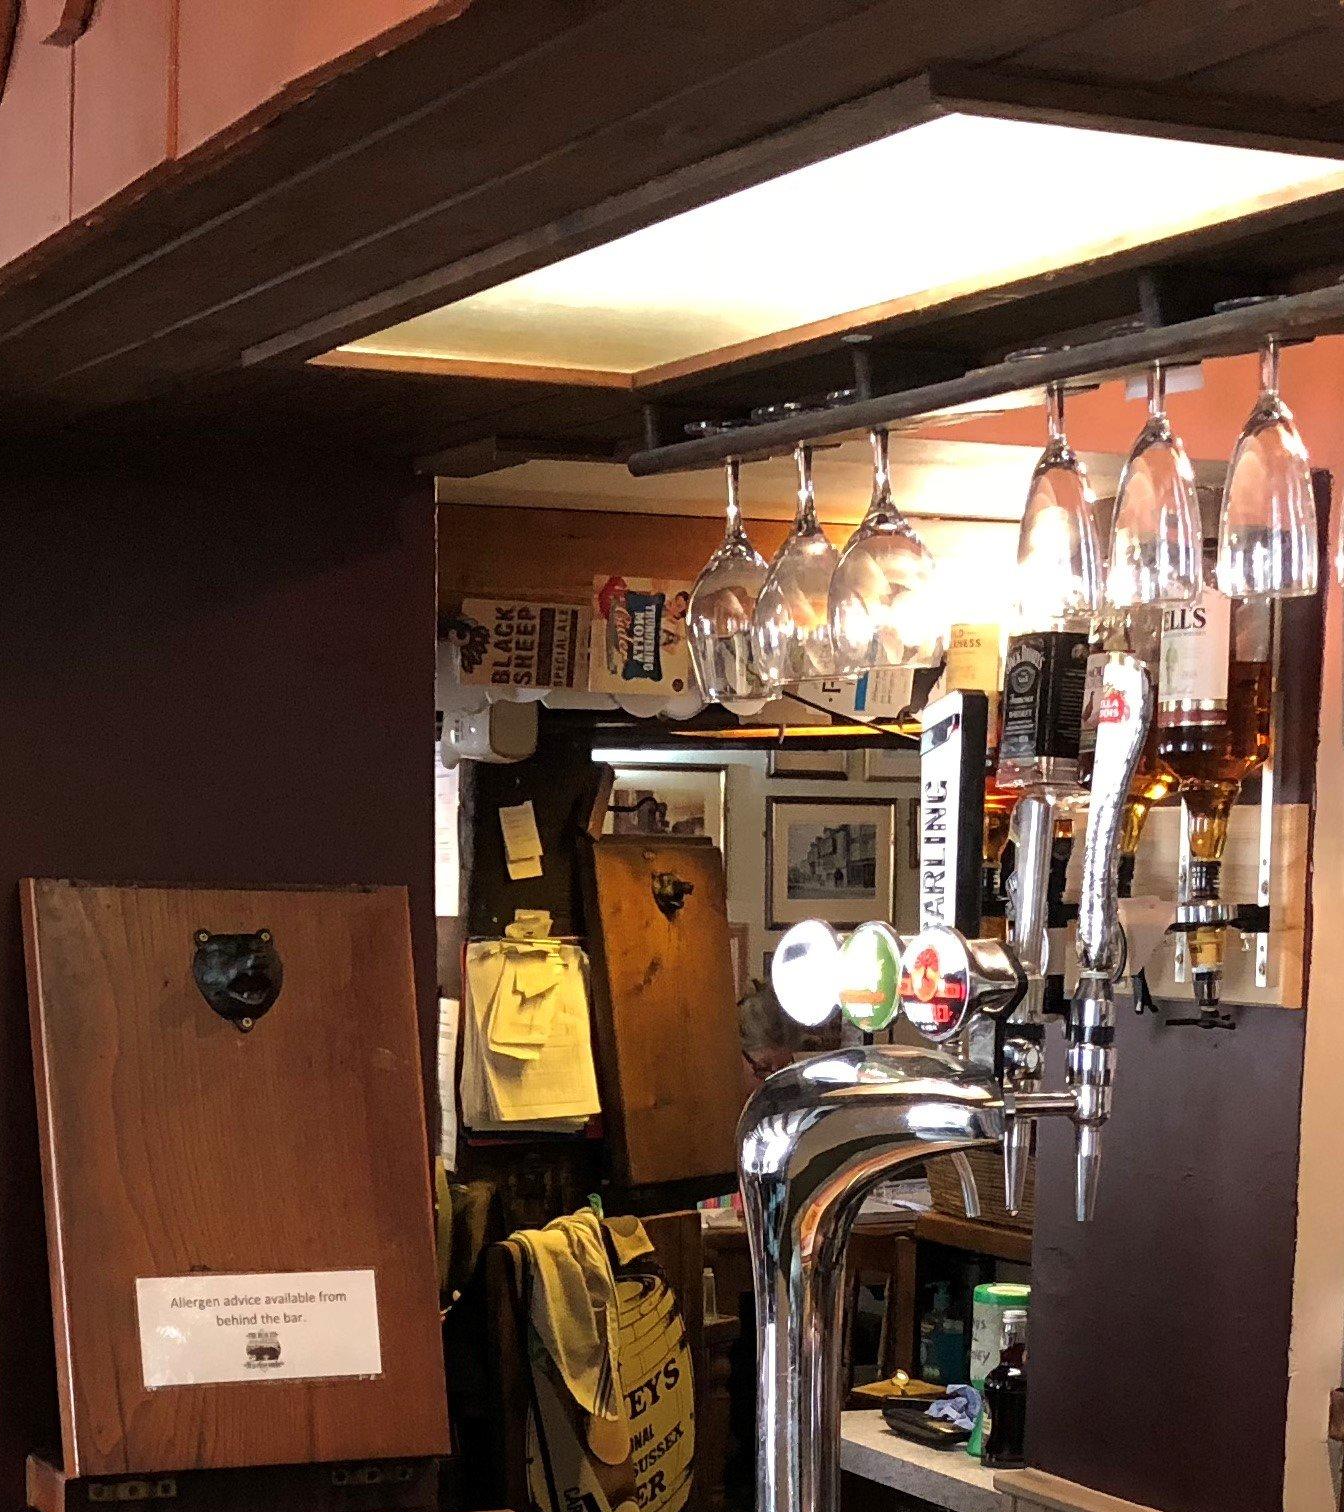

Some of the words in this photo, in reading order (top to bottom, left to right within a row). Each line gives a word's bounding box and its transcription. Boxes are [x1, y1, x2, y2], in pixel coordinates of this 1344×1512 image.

[1162, 607, 1207, 631] ELL'S
[491, 607, 514, 685] BLACK
[513, 606, 536, 686] SHEEP
[170, 1296, 220, 1310] Allergen
[223, 1294, 261, 1308] advice
[264, 1292, 316, 1306] available
[318, 1290, 347, 1303] from
[216, 1314, 257, 1327] behind
[261, 1313, 280, 1325] the
